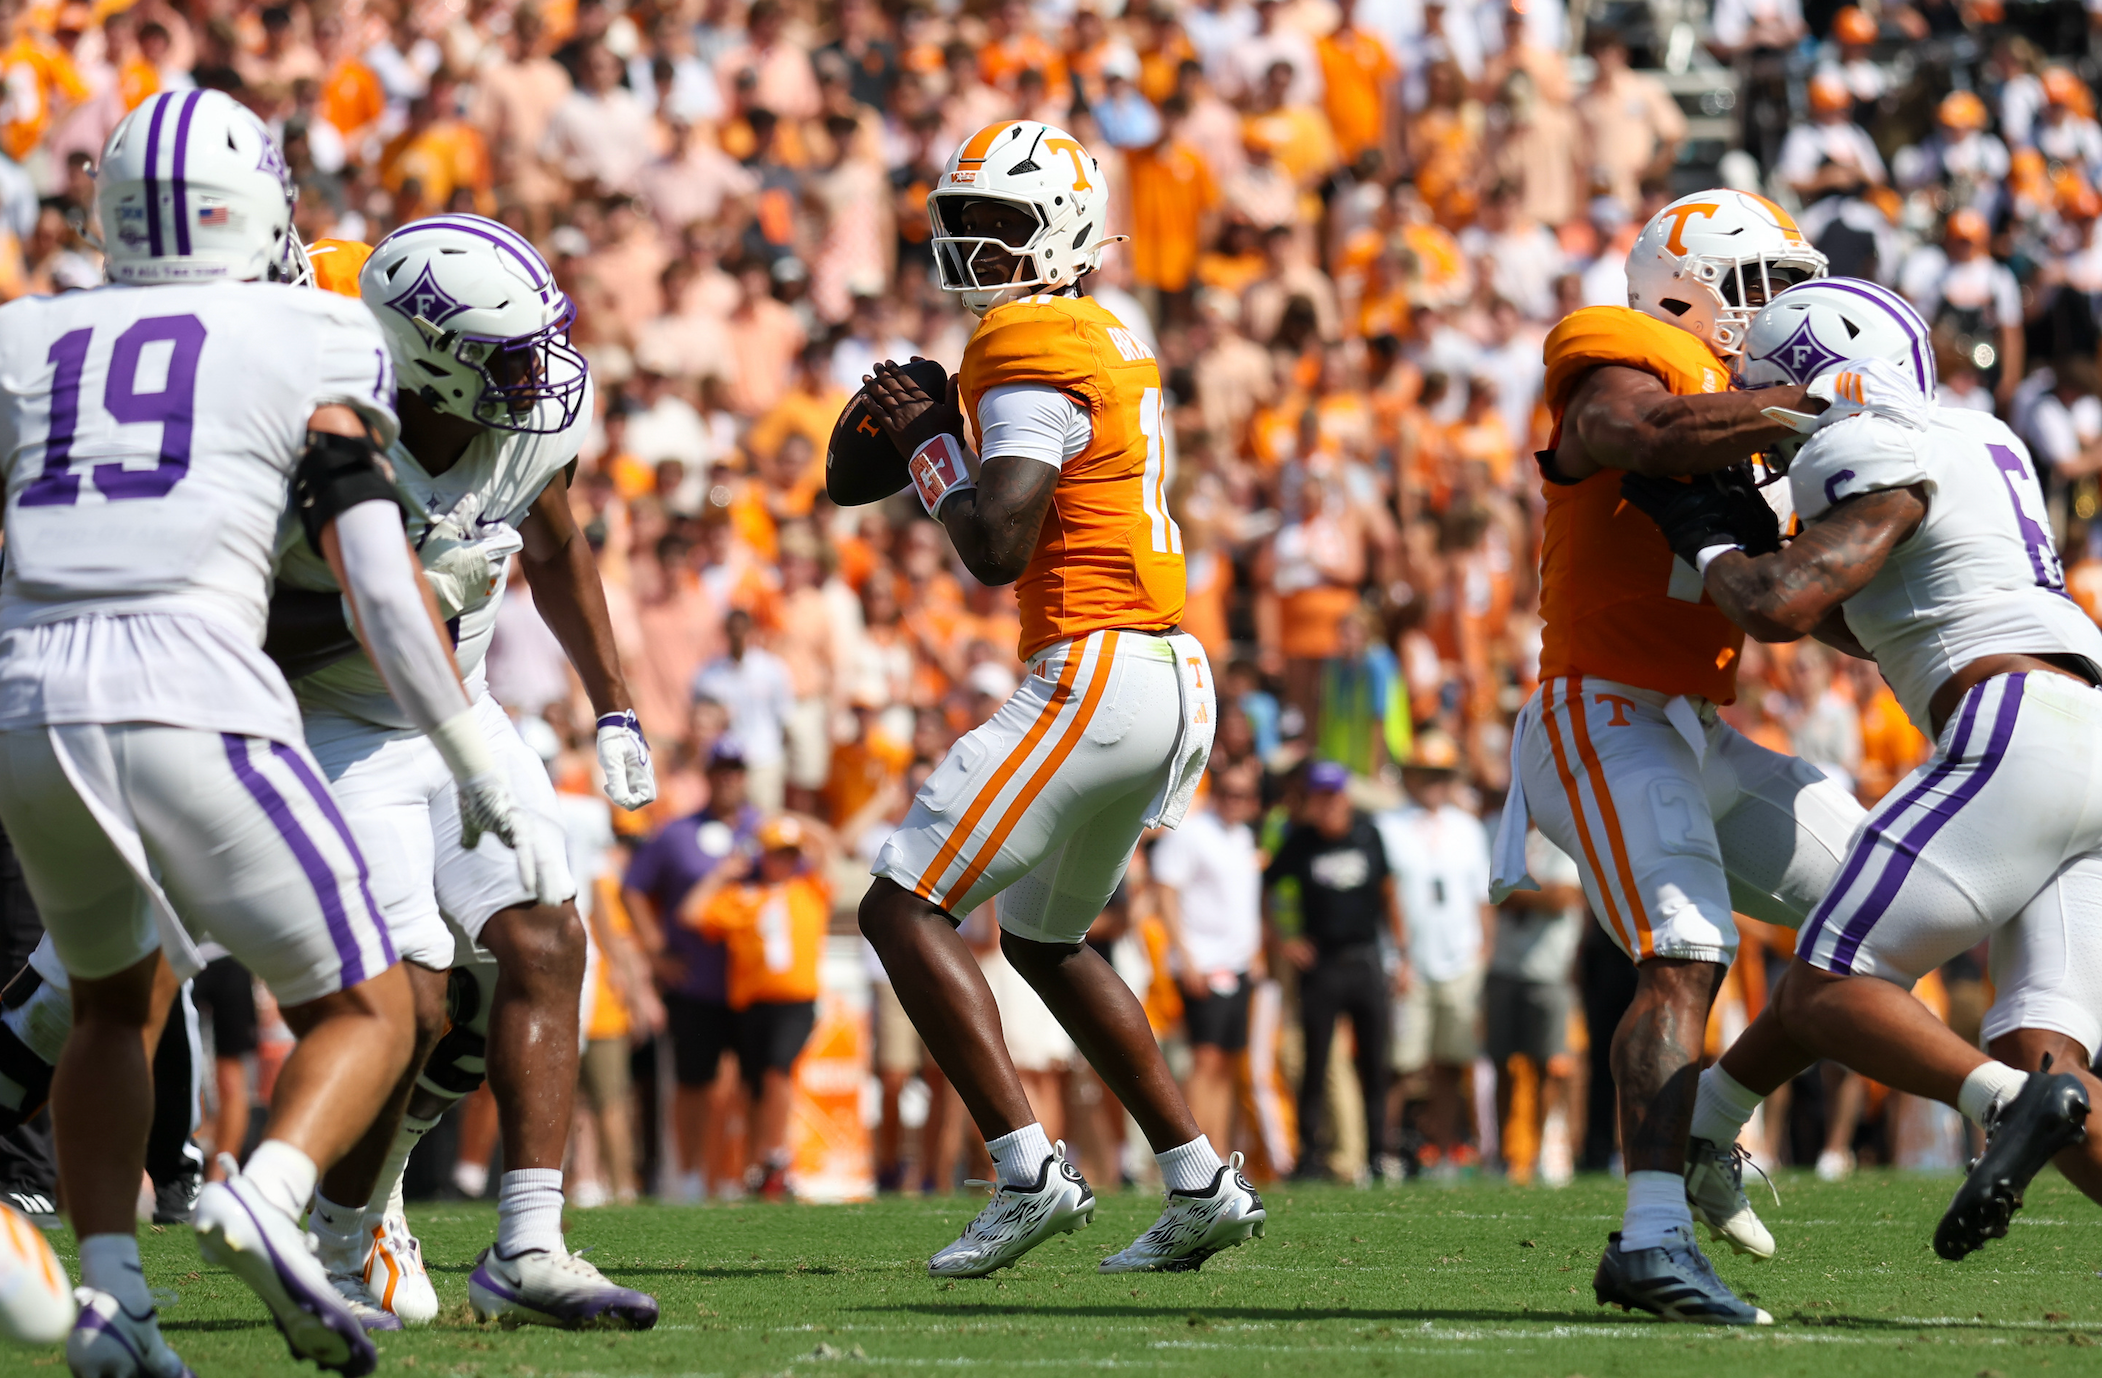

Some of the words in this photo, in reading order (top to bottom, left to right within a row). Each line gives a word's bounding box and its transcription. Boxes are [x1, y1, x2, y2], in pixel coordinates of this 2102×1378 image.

[1043, 138, 1093, 193] T
[1657, 203, 1721, 257] T
[415, 294, 436, 318] F
[1105, 327, 1156, 361] BRA
[1791, 345, 1812, 369] F
[18, 313, 207, 507] 19
[856, 414, 881, 438] T
[1139, 387, 1183, 554] 11
[1186, 656, 1203, 688] T
[1594, 693, 1636, 727] T
